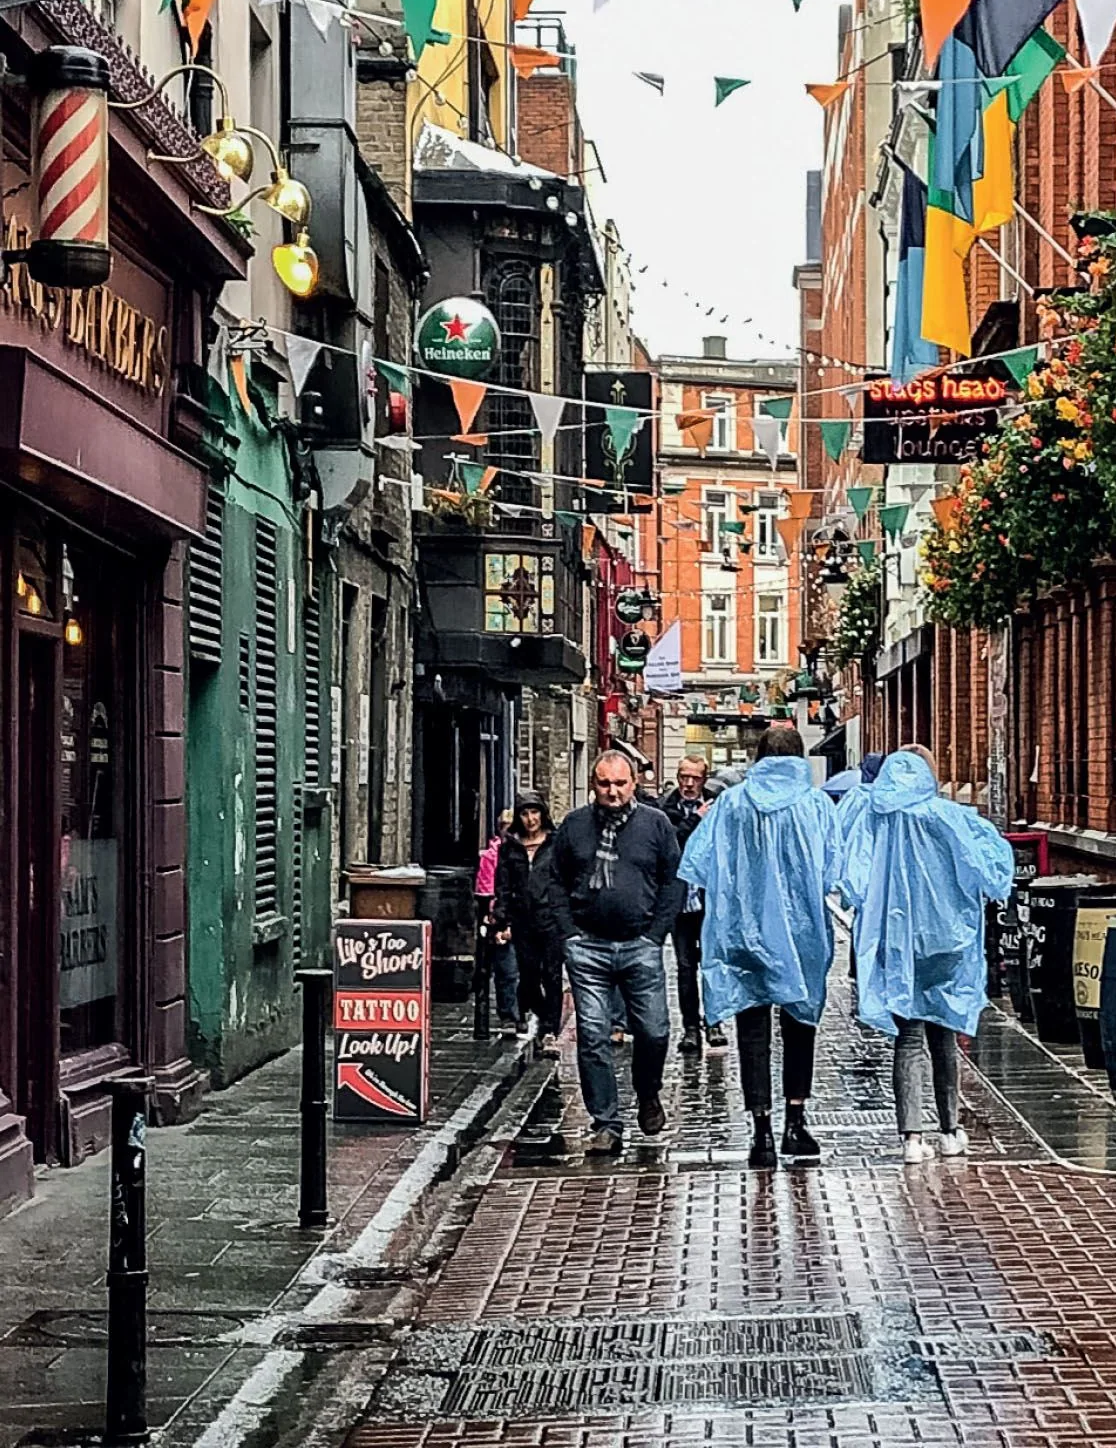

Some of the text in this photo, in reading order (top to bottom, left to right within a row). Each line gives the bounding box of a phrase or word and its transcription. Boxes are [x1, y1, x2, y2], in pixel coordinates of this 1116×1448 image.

[424, 347, 491, 360] Heineken
[942, 374, 1001, 400] head
[377, 932, 407, 950] Too
[361, 947, 423, 980] Short
[340, 998, 420, 1022] TATTOO
[338, 1033, 420, 1062] Look Up!
